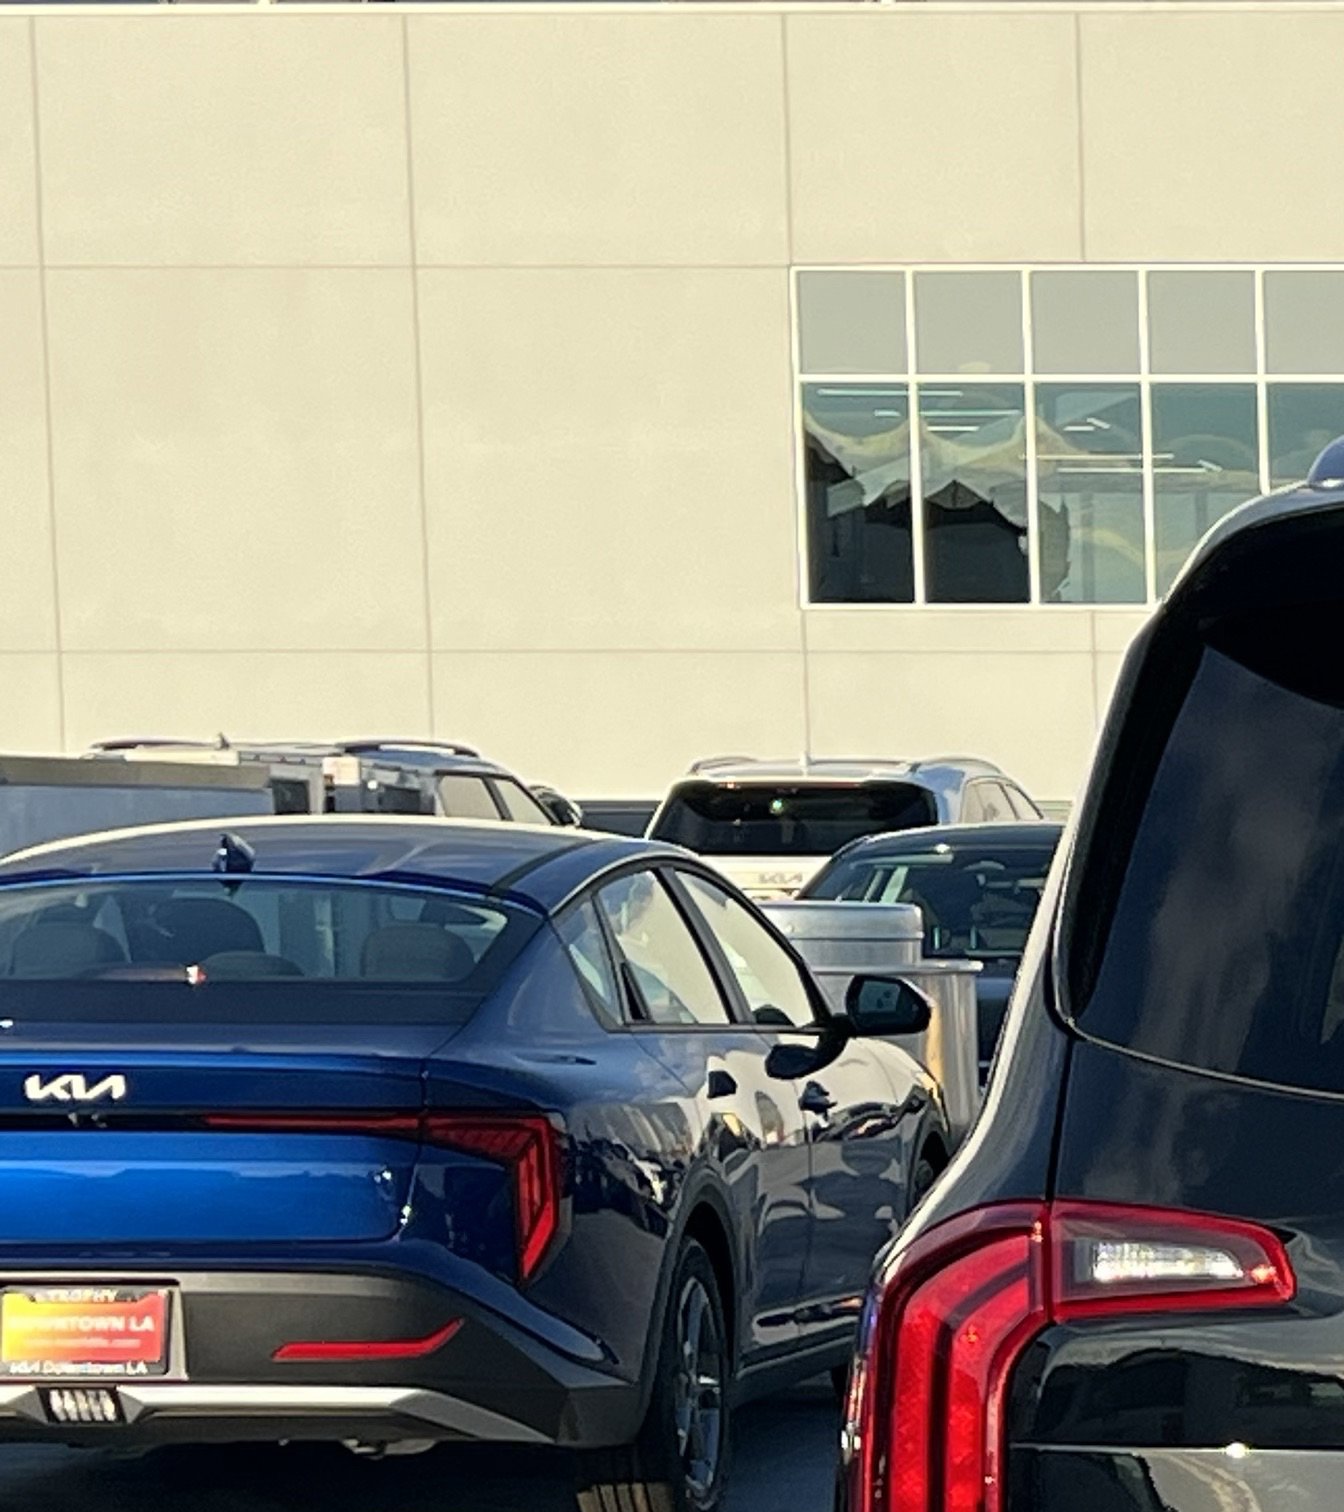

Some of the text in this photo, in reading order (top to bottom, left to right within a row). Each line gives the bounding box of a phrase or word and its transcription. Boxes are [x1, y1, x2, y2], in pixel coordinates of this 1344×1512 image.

[24, 1074, 126, 1100] KIA
[10, 1316, 155, 1331] NTOWN LA
[126, 1361, 148, 1375] LA
